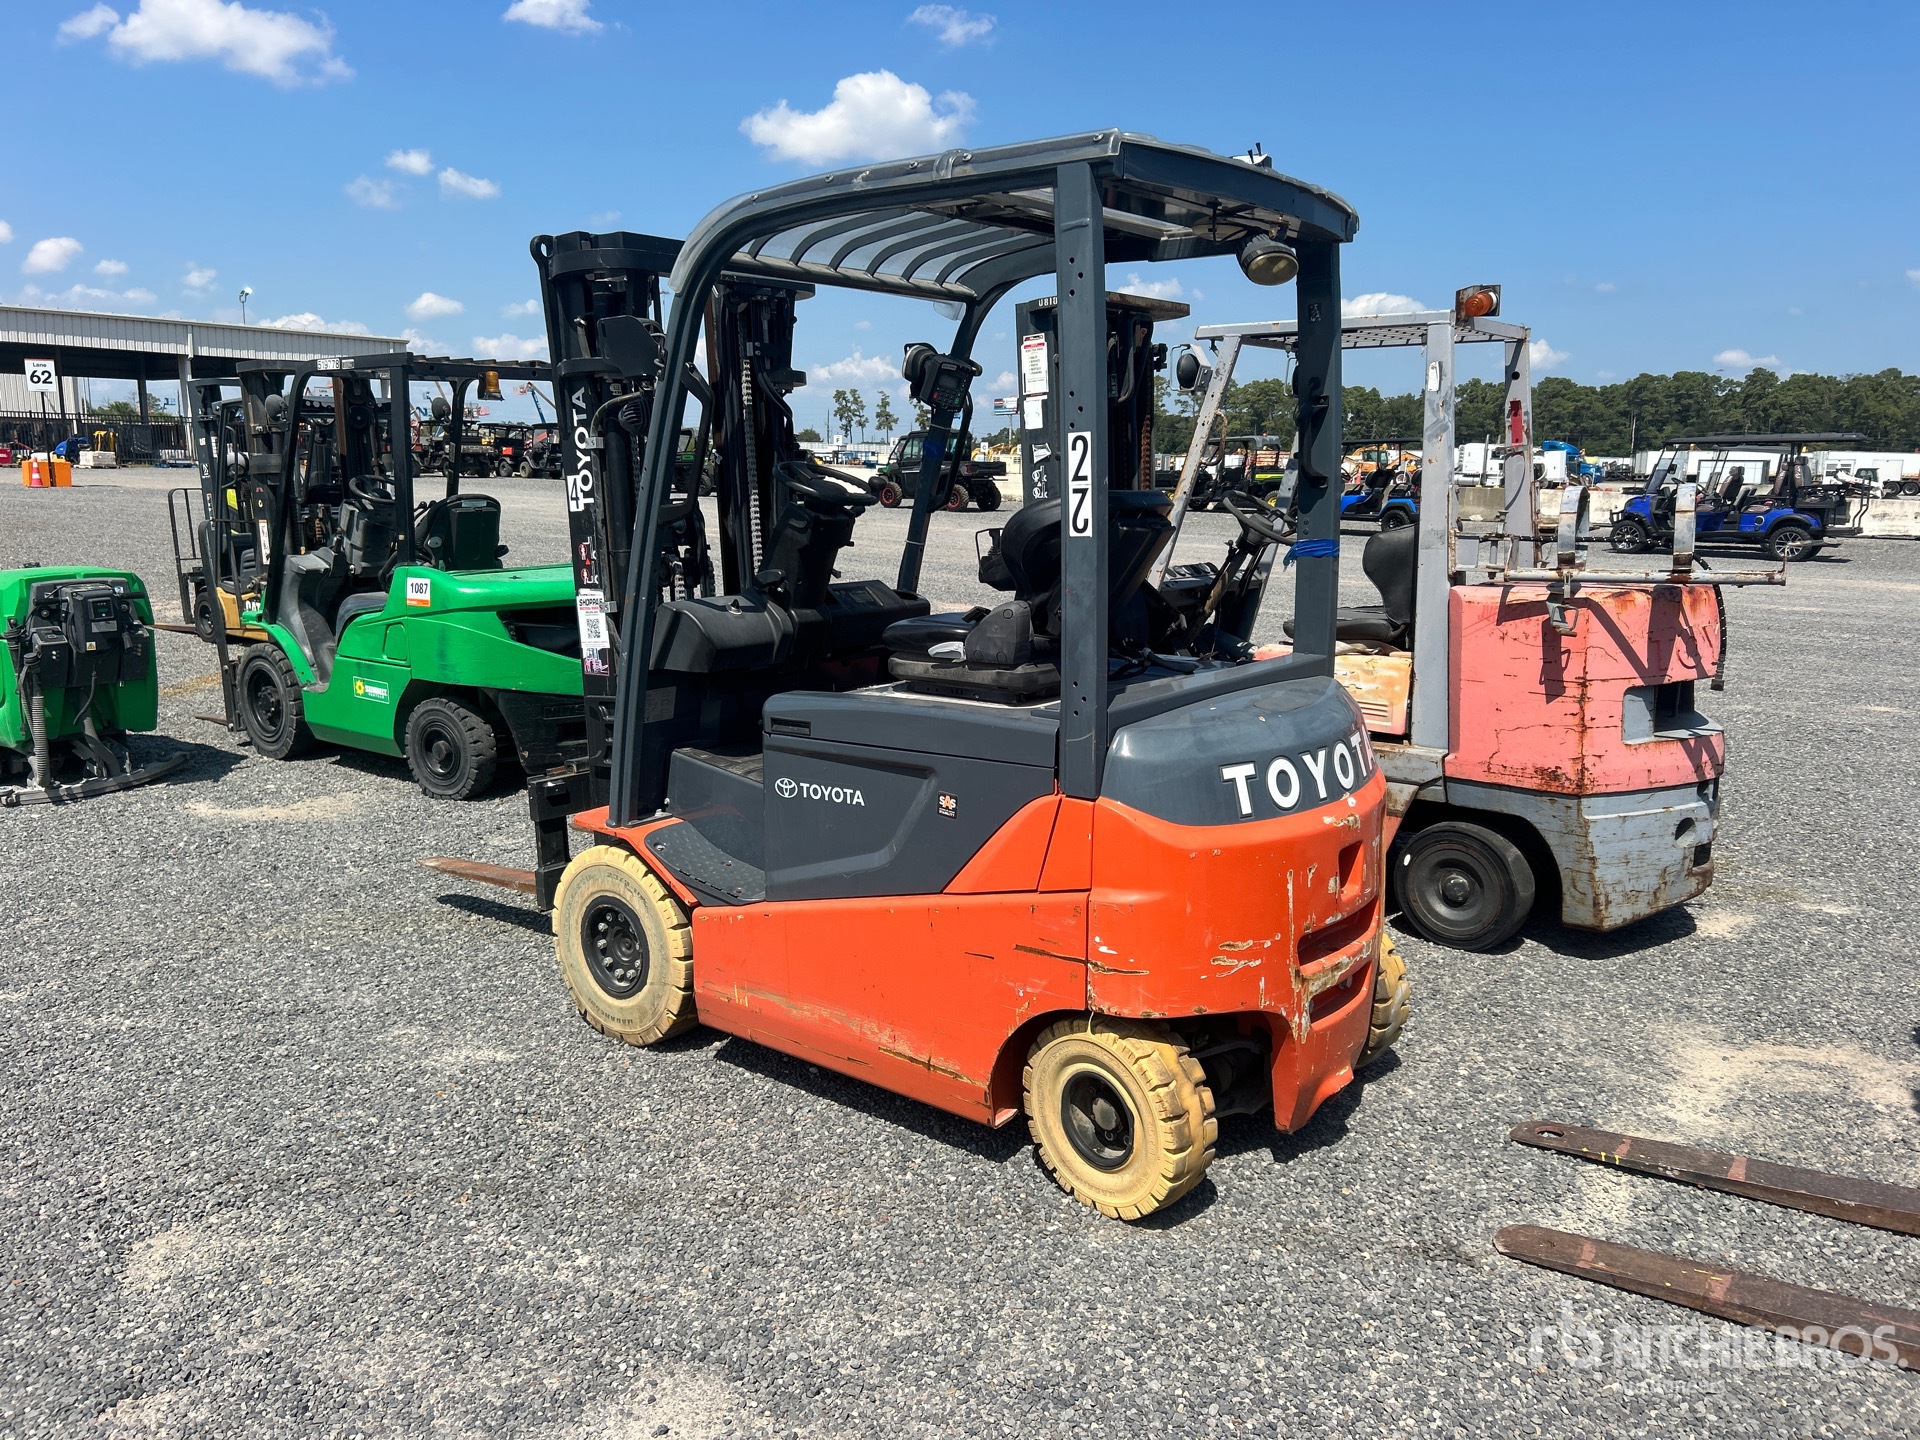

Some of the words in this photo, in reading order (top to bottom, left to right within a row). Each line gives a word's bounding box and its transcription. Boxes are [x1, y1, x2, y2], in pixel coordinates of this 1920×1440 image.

[29, 370, 53, 385] 62
[572, 386, 595, 511] TOYOTA
[570, 477, 580, 510] 4
[410, 582, 429, 595] 1087
[1222, 724, 1376, 816] TOYOTA
[799, 782, 866, 807] TOYOTA
[939, 795, 956, 810] SAS
